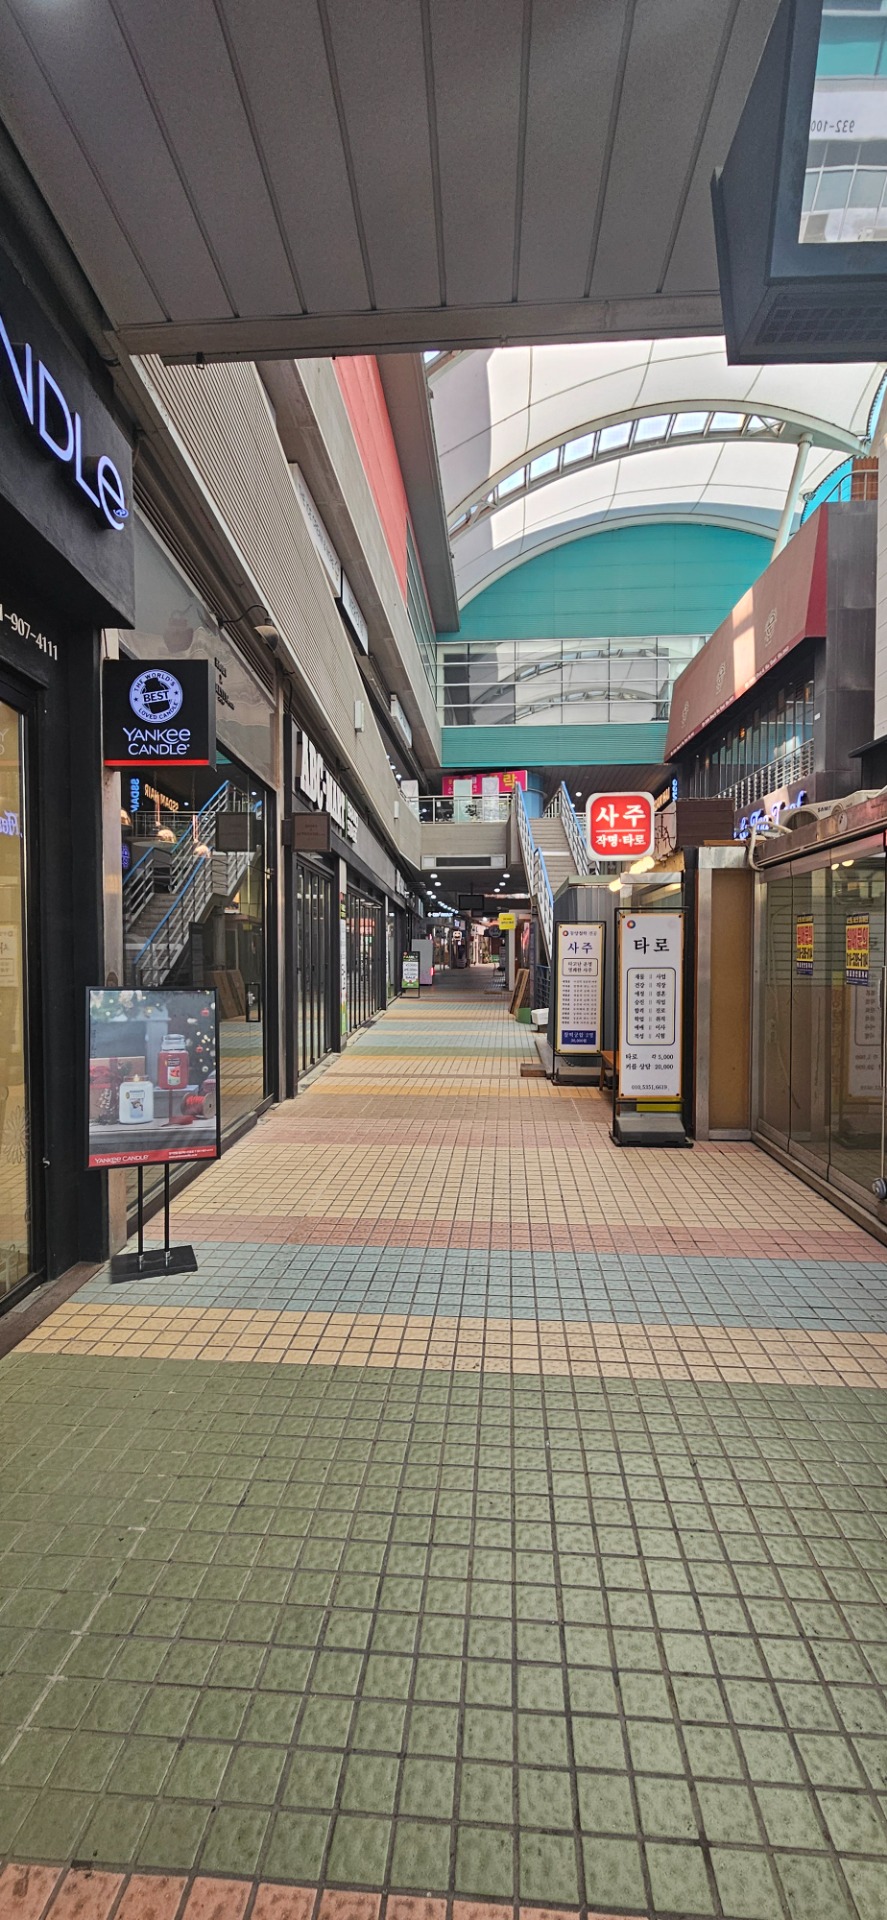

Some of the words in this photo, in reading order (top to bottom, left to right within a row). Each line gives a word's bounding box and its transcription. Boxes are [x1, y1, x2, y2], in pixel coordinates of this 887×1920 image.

[134, 681, 144, 692] THE
[143, 690, 170, 703] BEST
[138, 708, 158, 720] LOVED
[596, 804, 646, 828] 사주
[568, 942, 593, 955] 사주
[633, 936, 670, 955] 타로
[625, 1053, 639, 1061] 타로
